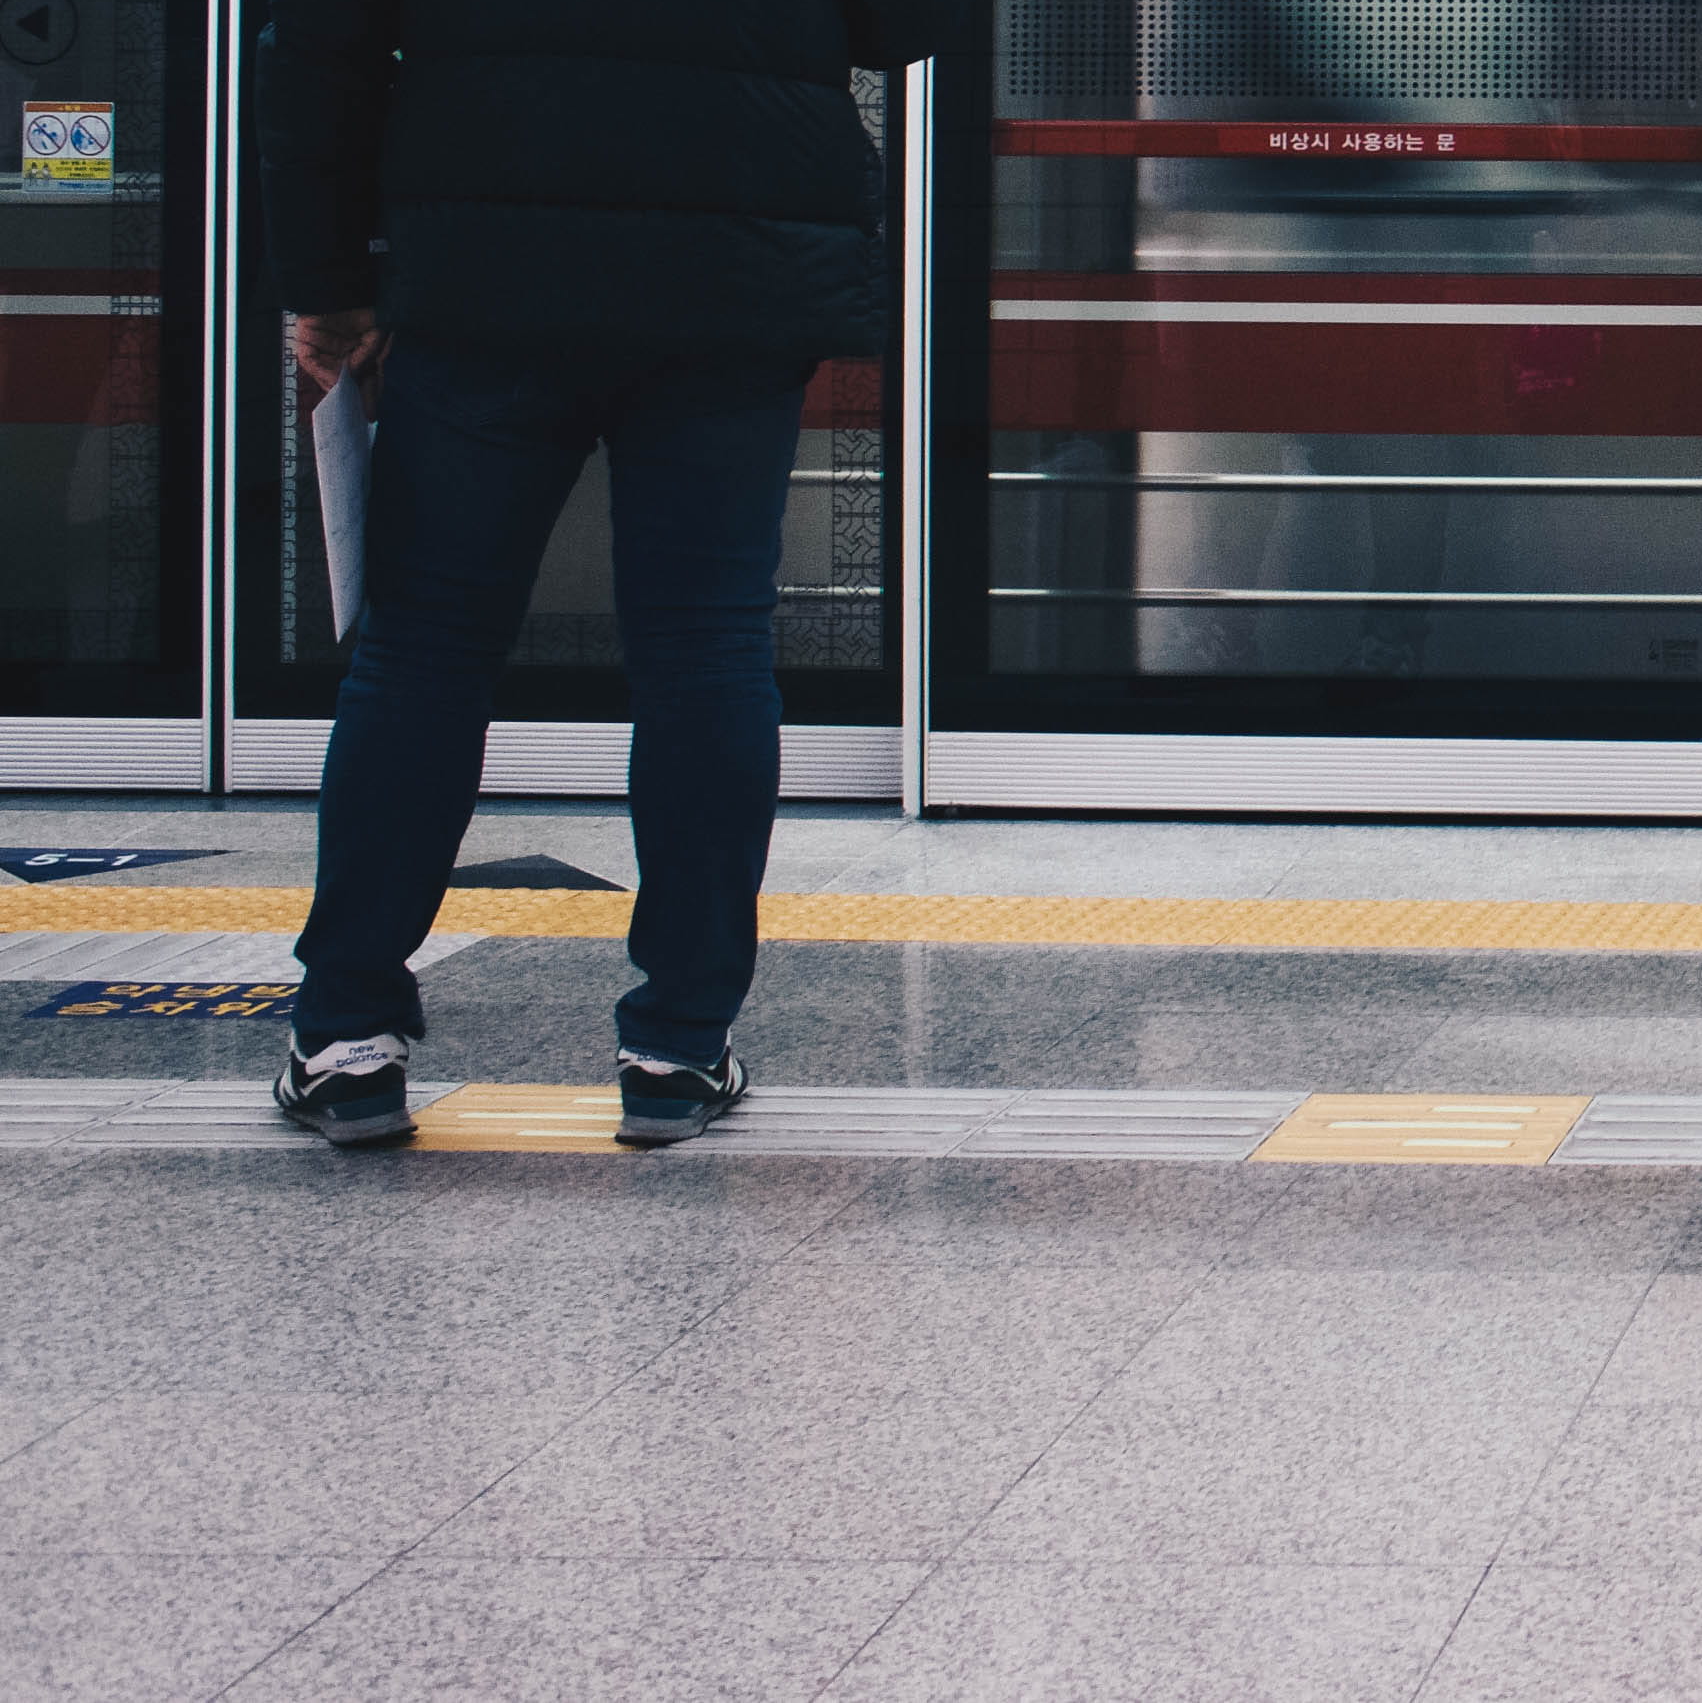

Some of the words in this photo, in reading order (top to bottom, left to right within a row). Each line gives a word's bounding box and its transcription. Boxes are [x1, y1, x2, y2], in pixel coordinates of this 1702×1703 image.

[1269, 132, 1330, 151] 비상시
[1341, 133, 1424, 152] 사용하는
[1436, 134, 1455, 152] 문
[25, 853, 139, 867] 5-1
[56, 1000, 295, 1016] 승차위
